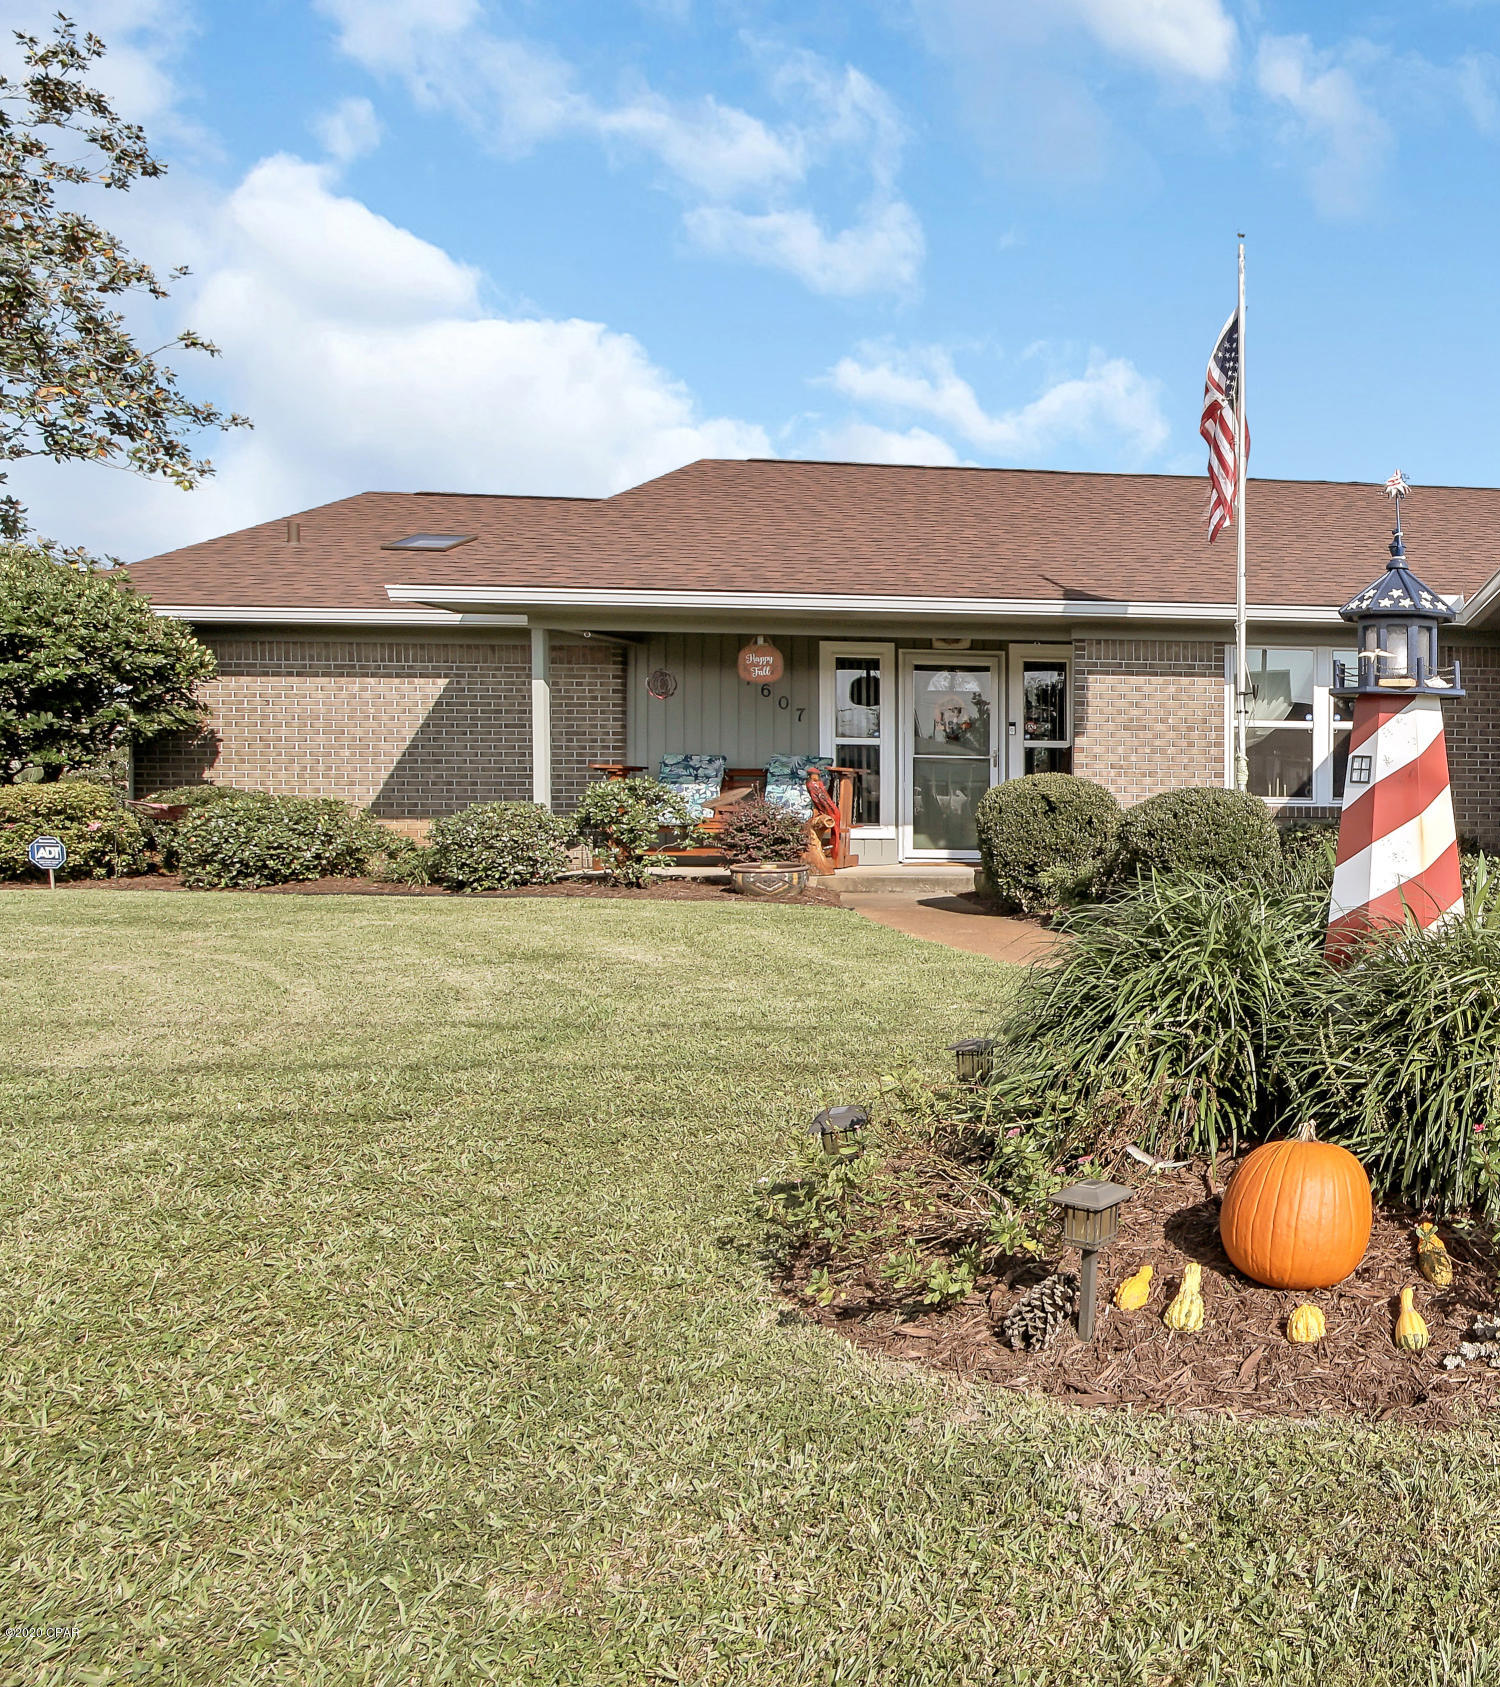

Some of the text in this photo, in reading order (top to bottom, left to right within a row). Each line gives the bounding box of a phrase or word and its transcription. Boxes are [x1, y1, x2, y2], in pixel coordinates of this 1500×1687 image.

[745, 653, 773, 665] Happy
[750, 666, 771, 677] Fall
[746, 681, 806, 722] 607
[36, 846, 60, 859] ADT
